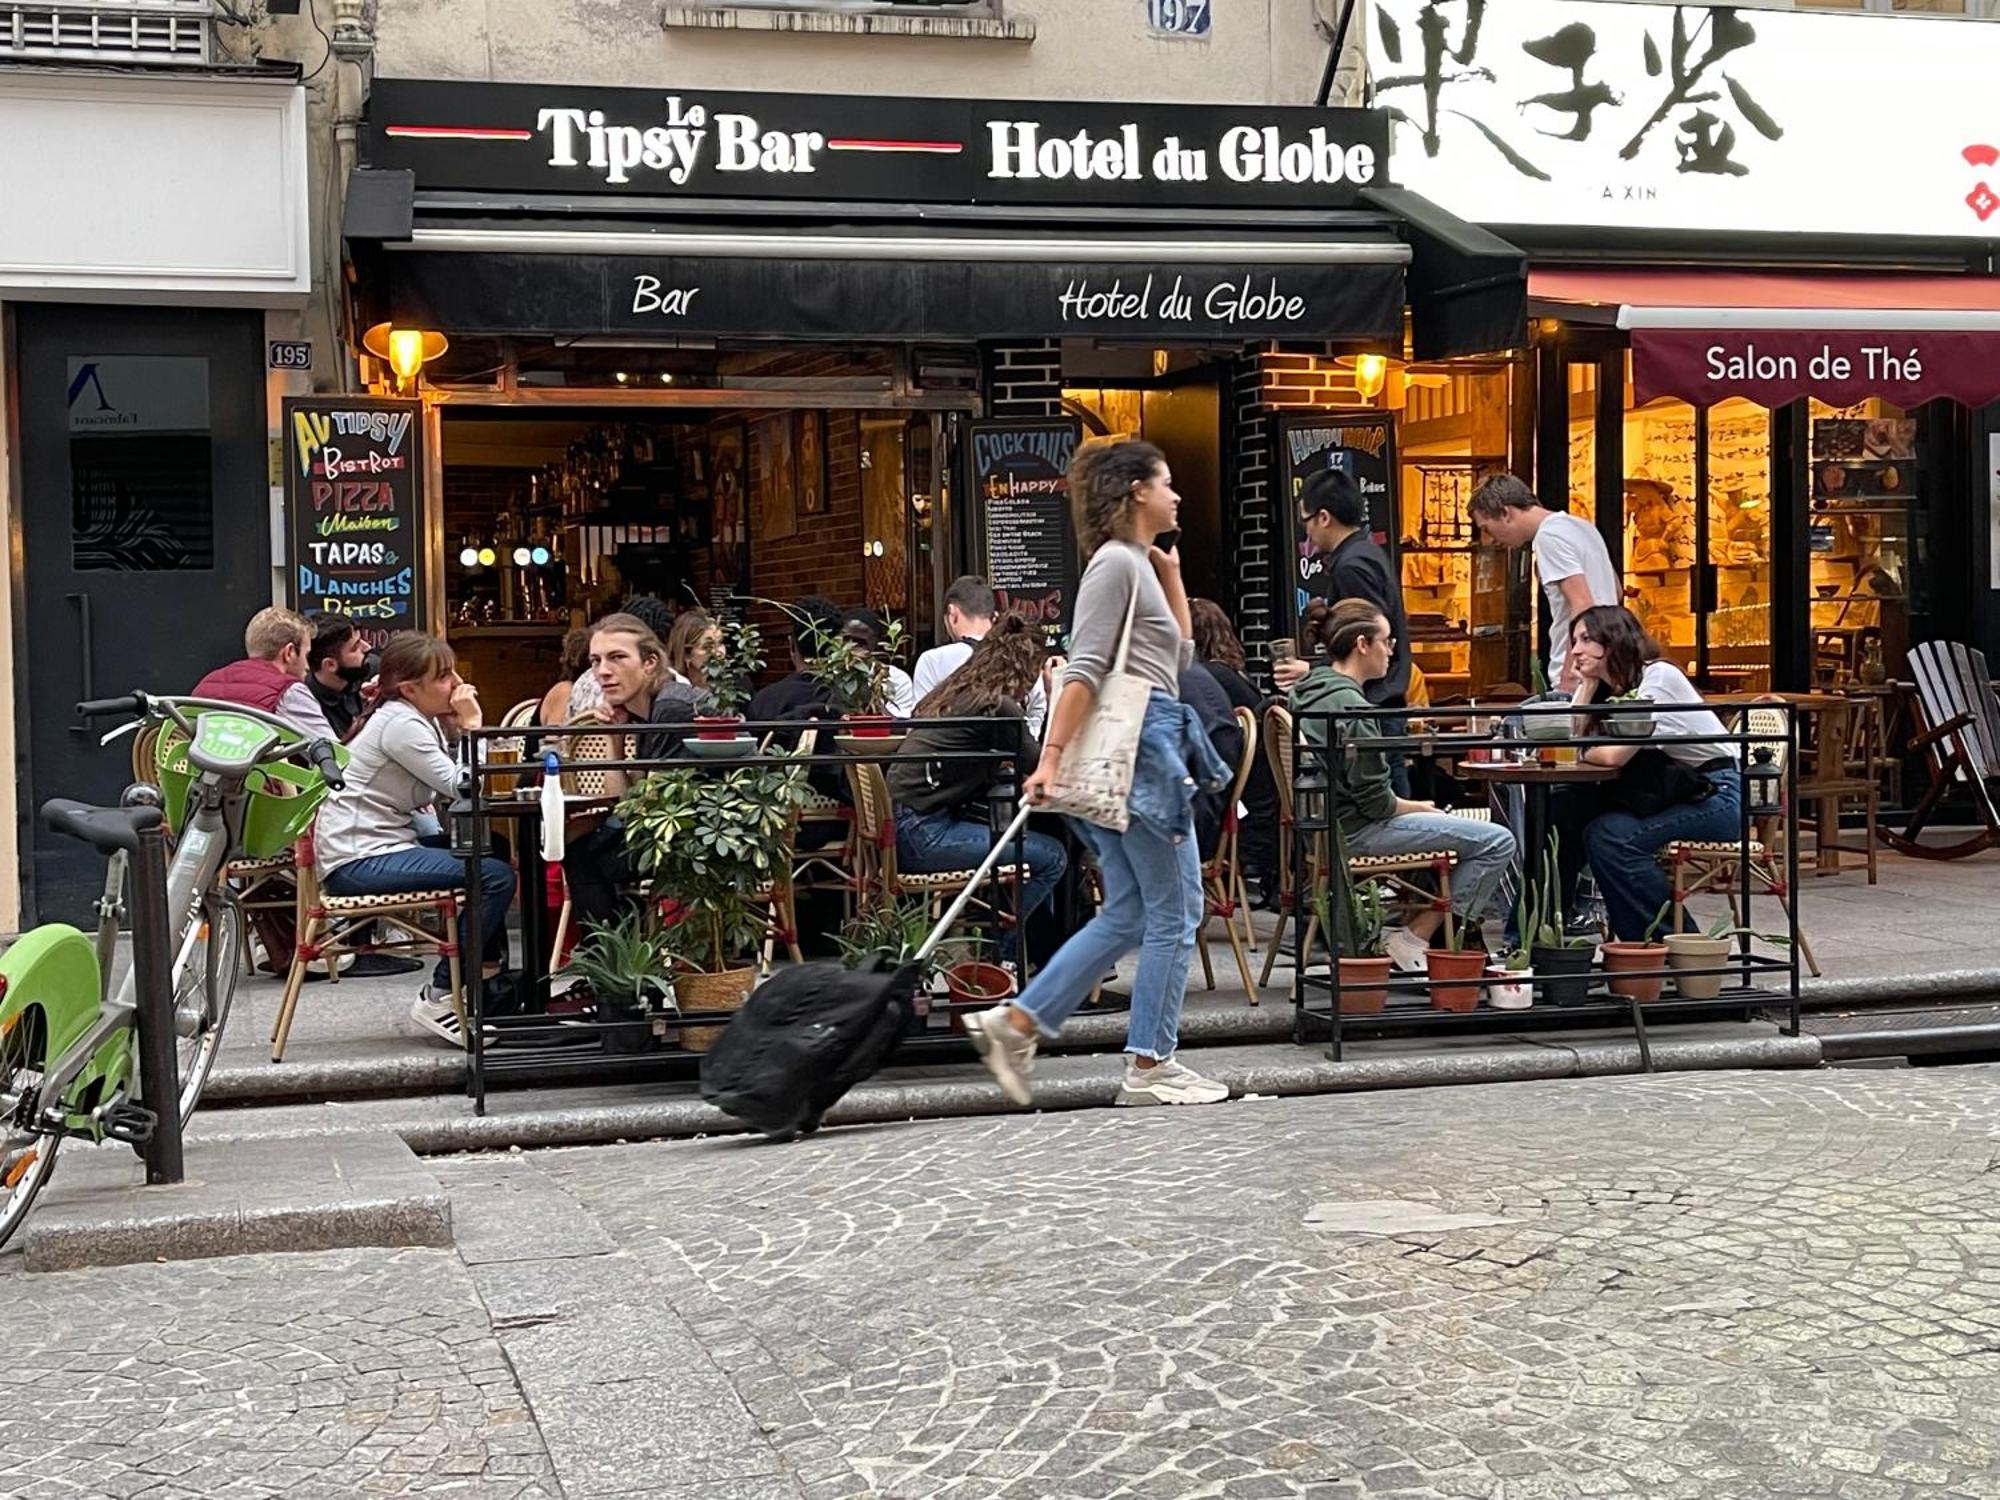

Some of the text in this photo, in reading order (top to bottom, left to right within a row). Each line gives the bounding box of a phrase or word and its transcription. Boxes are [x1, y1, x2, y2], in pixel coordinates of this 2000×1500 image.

[1153, 0, 1206, 32] 197
[667, 96, 705, 127] Le
[537, 108, 826, 186] Tipsy Bar
[986, 120, 1376, 184] Hotel du Globe
[631, 275, 701, 317] Bar
[1058, 274, 1307, 324] Hotel du Globe
[274, 346, 308, 365] 195
[1706, 345, 1923, 383] Salon de Thé
[331, 411, 412, 456] TIPSY
[974, 431, 1074, 477] COCKTAILS
[311, 480, 395, 513] PIZZA
[320, 512, 400, 537] Maison
[308, 542, 385, 566] TAPAS
[300, 565, 412, 595] PLANCHES
